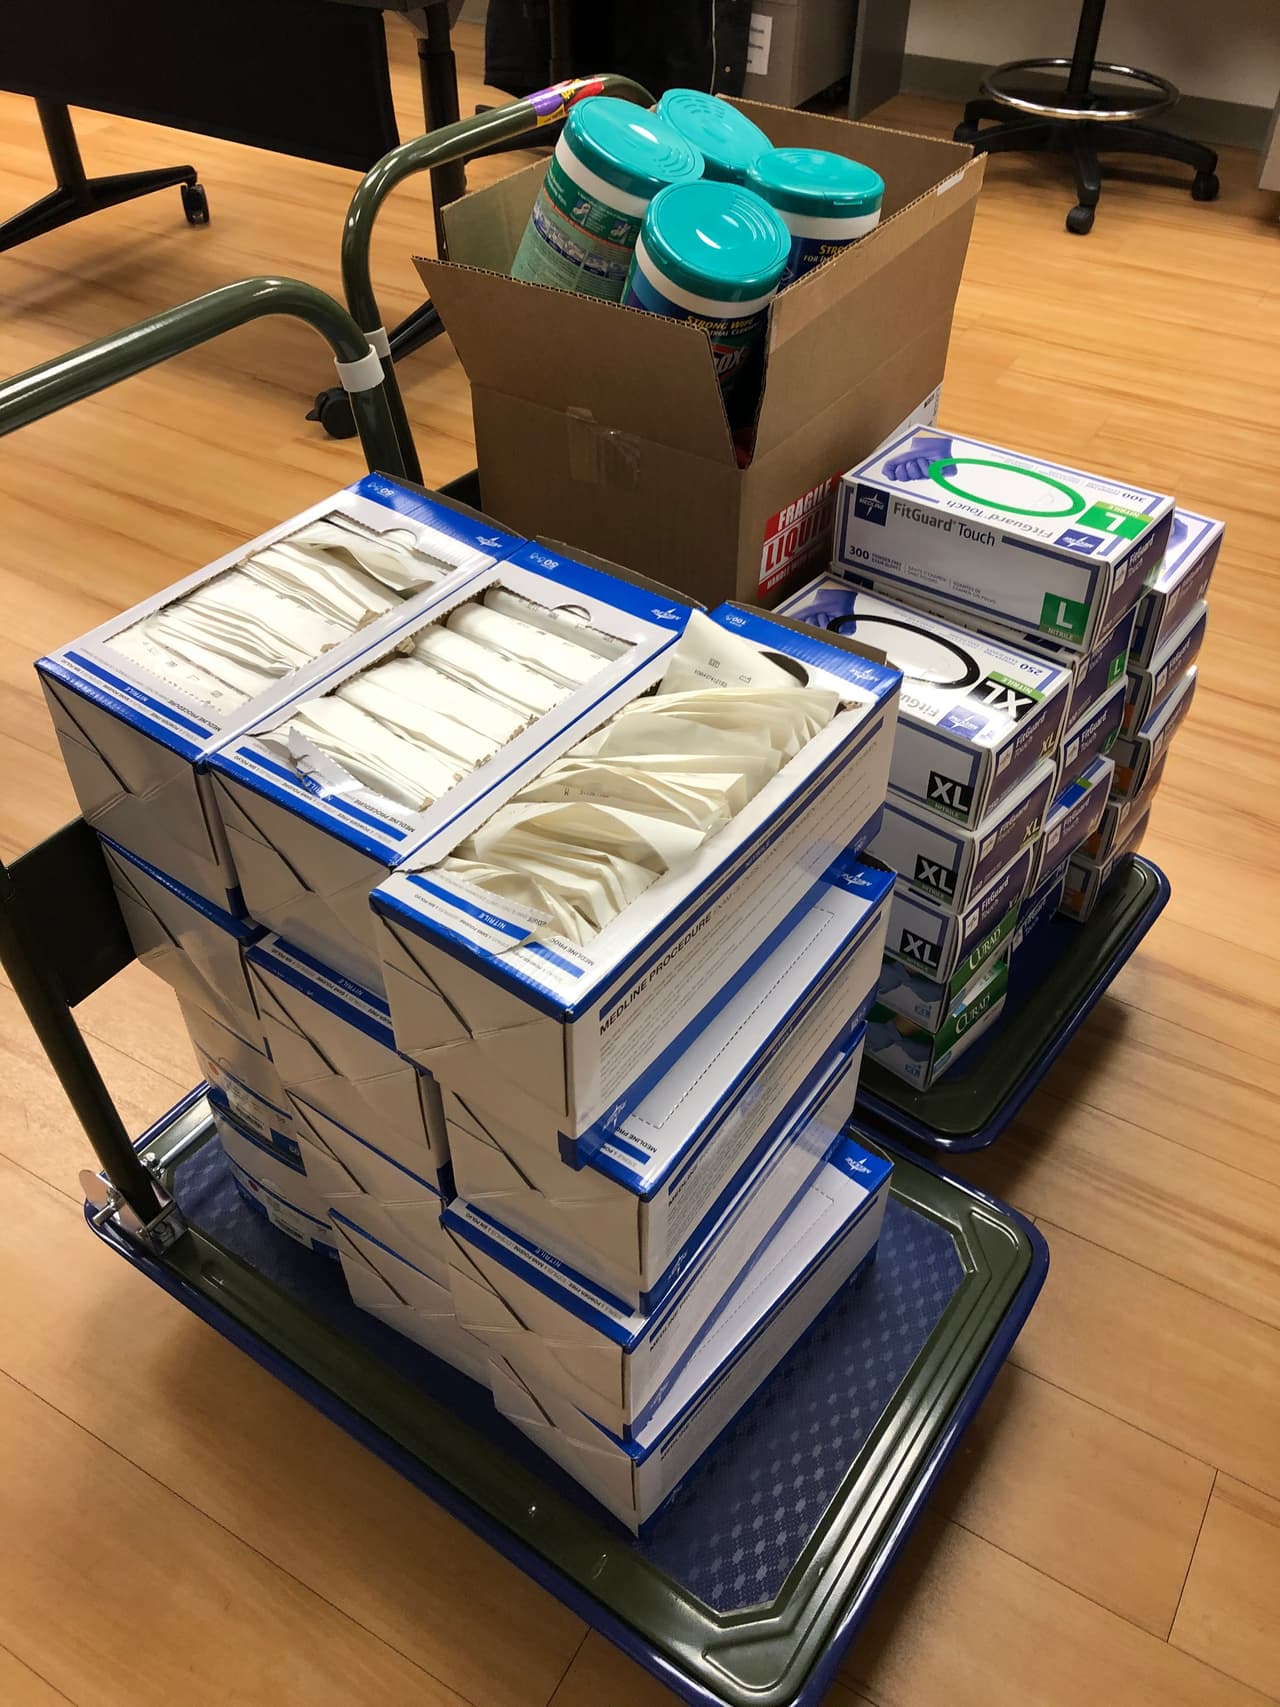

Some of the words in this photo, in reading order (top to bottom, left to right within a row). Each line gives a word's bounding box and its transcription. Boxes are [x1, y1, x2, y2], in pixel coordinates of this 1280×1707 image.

[777, 477, 833, 532] FRAGILE
[945, 500, 984, 518] Touch
[1121, 491, 1148, 503] 300
[893, 502, 953, 532] FitGuard
[958, 522, 995, 547] Touch
[989, 513, 1054, 539] FitGuard
[1104, 511, 1126, 532] L
[849, 545, 870, 560] 300
[1055, 600, 1073, 630] L
[1047, 627, 1075, 642] NITRILE
[1019, 662, 1043, 676] 250
[124, 684, 149, 703] NITRILE
[1001, 676, 1034, 694] NITRILE
[981, 681, 1033, 718] XL
[1016, 710, 1047, 748] FitGuard
[1081, 710, 1108, 742] FitGuard
[1040, 731, 1056, 755] XL
[931, 775, 969, 813] XL
[388, 815, 415, 834] MEDLINE
[1023, 817, 1041, 841] XL
[917, 858, 953, 894] XL
[981, 875, 1010, 911] FitGuard
[477, 910, 506, 930] NITRILE
[565, 945, 596, 966] MEDLINE
[903, 932, 938, 967] XL
[969, 926, 1001, 971] CURAD
[599, 977, 649, 1036] MEDLINE
[648, 911, 713, 983] PROCEDURE
[337, 976, 364, 996] NITRILE
[955, 994, 991, 1035] CURAD
[627, 1133, 658, 1153] MEDLINE
[533, 1246, 563, 1268] NITRILE
